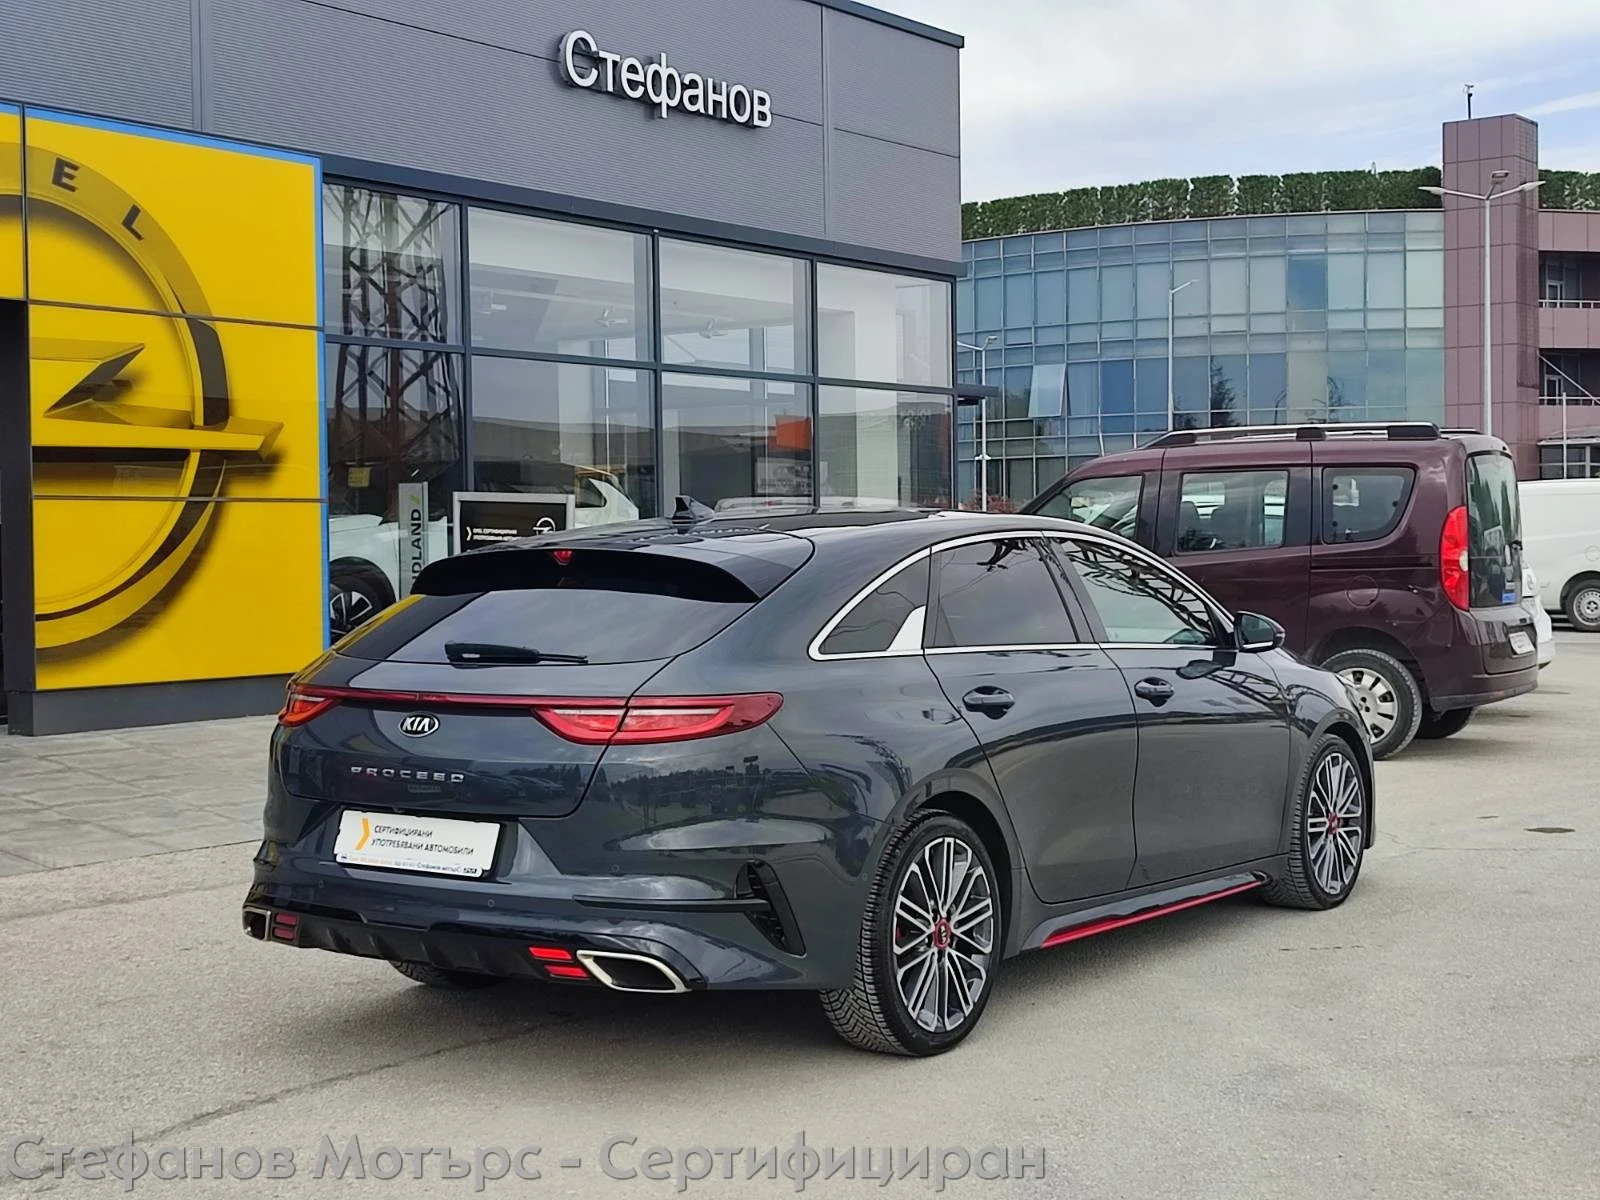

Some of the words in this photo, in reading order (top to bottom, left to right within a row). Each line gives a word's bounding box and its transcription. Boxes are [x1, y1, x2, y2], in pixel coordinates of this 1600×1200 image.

[563, 29, 773, 128] Стефанов
[410, 508, 422, 580] DLAND
[402, 716, 431, 732] KIA
[351, 766, 464, 783] PROCEED
[374, 824, 433, 838] СЕРТИФИЦИРАНИ
[371, 838, 424, 851] УПОТРЕБЯВАНИ
[424, 844, 475, 856] АВТОМОБИЛИ
